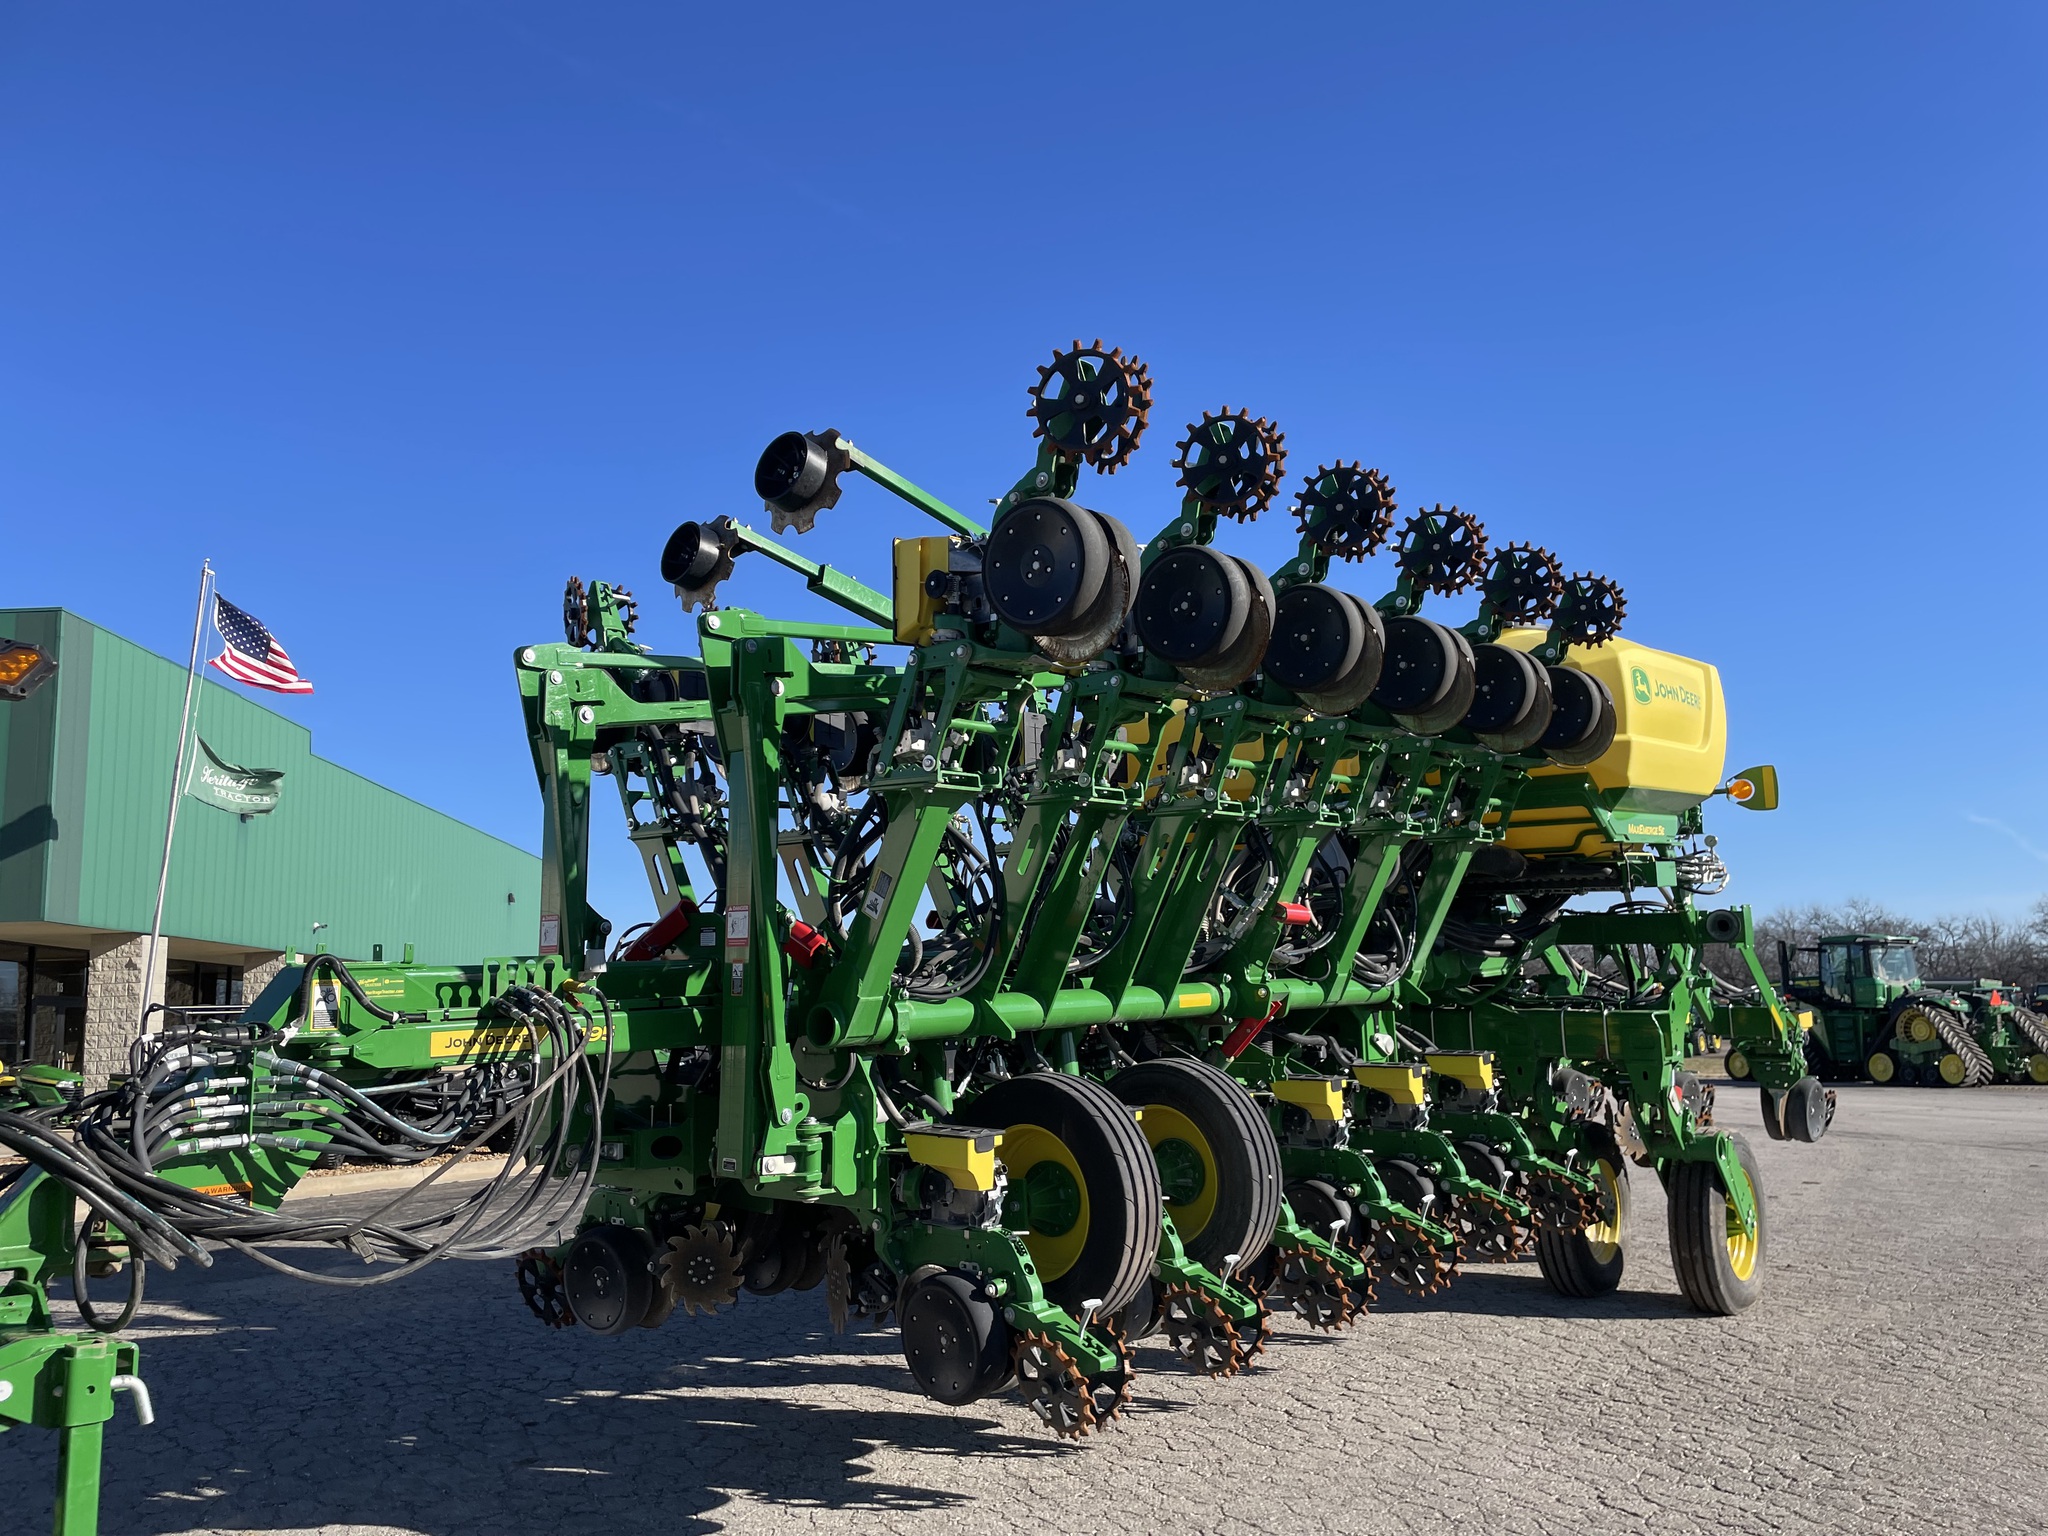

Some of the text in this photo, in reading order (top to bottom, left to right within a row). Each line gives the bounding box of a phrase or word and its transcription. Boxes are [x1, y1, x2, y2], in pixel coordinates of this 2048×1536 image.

[1654, 679, 1702, 711] JOHN DEERE
[201, 766, 258, 790] Heritage
[213, 786, 271, 804] TRACTOR
[445, 1033, 530, 1048] JOHN DEERE
[210, 1184, 246, 1194] WARNING
